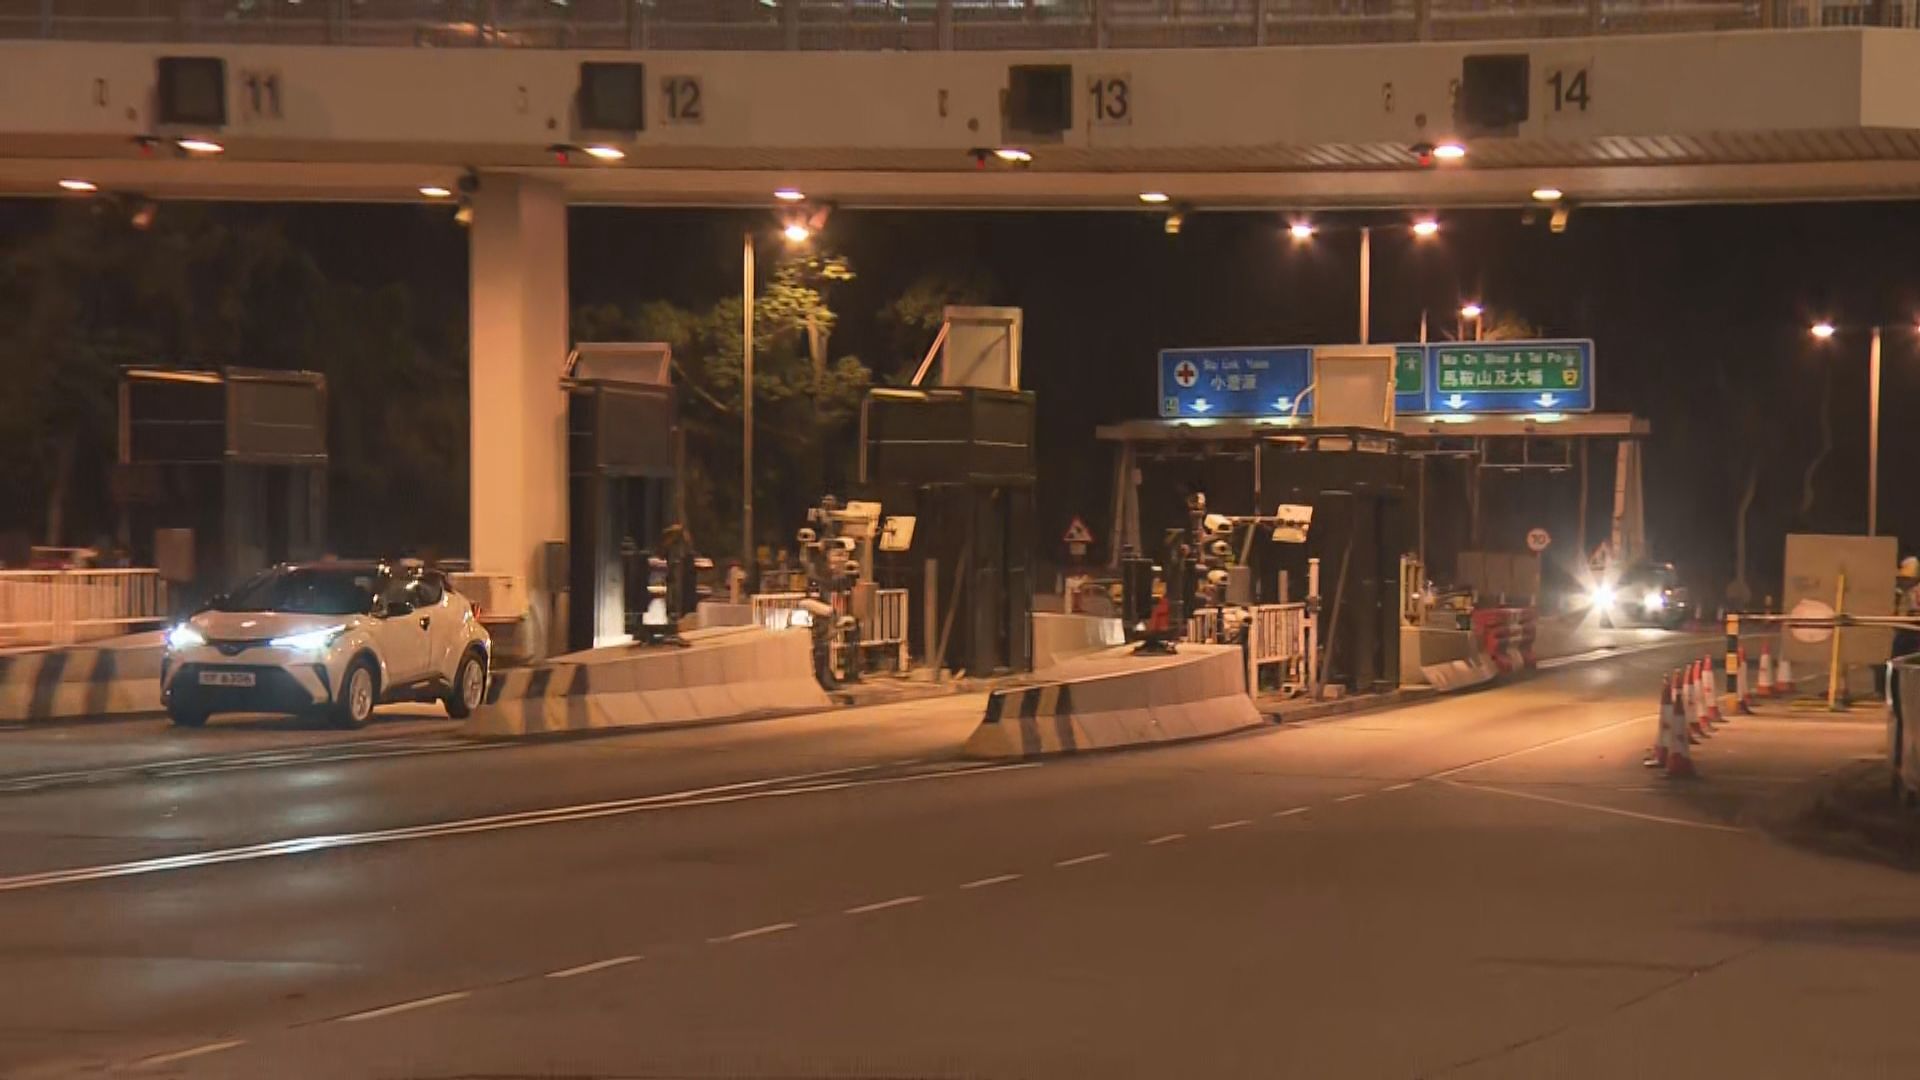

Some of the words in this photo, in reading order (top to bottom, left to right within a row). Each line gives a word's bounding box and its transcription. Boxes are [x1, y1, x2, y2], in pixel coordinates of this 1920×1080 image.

[244, 73, 280, 113] 11
[663, 79, 700, 119] 12
[1090, 78, 1127, 119] 13
[1546, 69, 1590, 112] 14
[1547, 351, 1562, 363] Po
